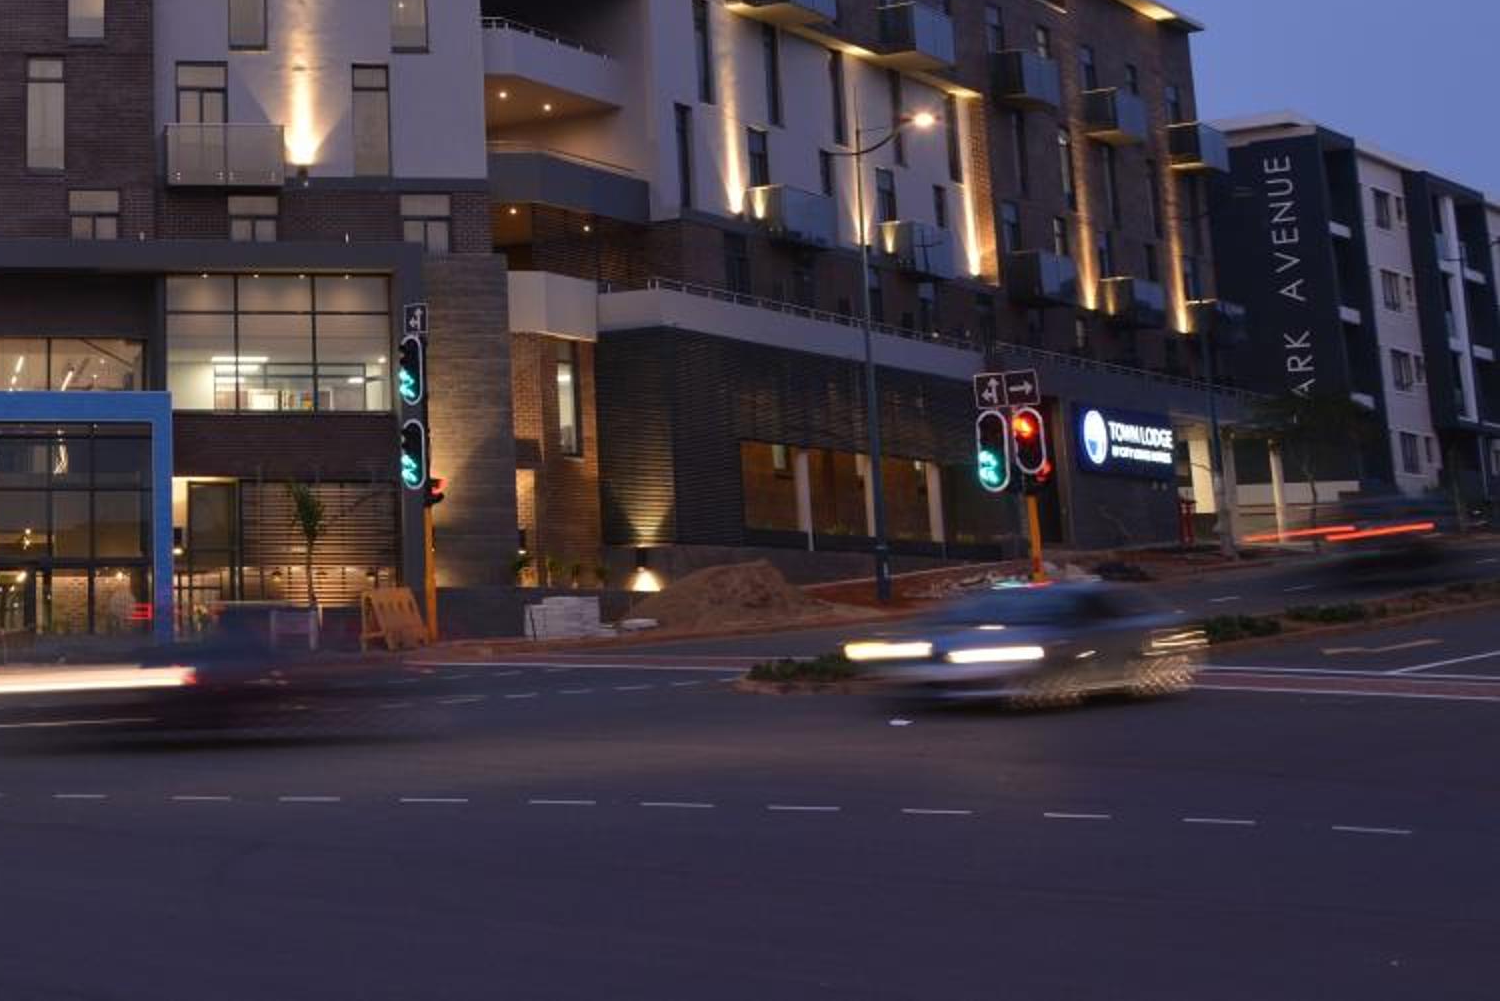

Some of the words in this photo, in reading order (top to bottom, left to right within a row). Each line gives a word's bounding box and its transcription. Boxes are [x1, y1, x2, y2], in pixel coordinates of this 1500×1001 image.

[1263, 155, 1306, 302] AVENUE
[1283, 330, 1317, 423] ARK
[1108, 421, 1140, 443] TOWN
[1140, 426, 1173, 449] LODGE
